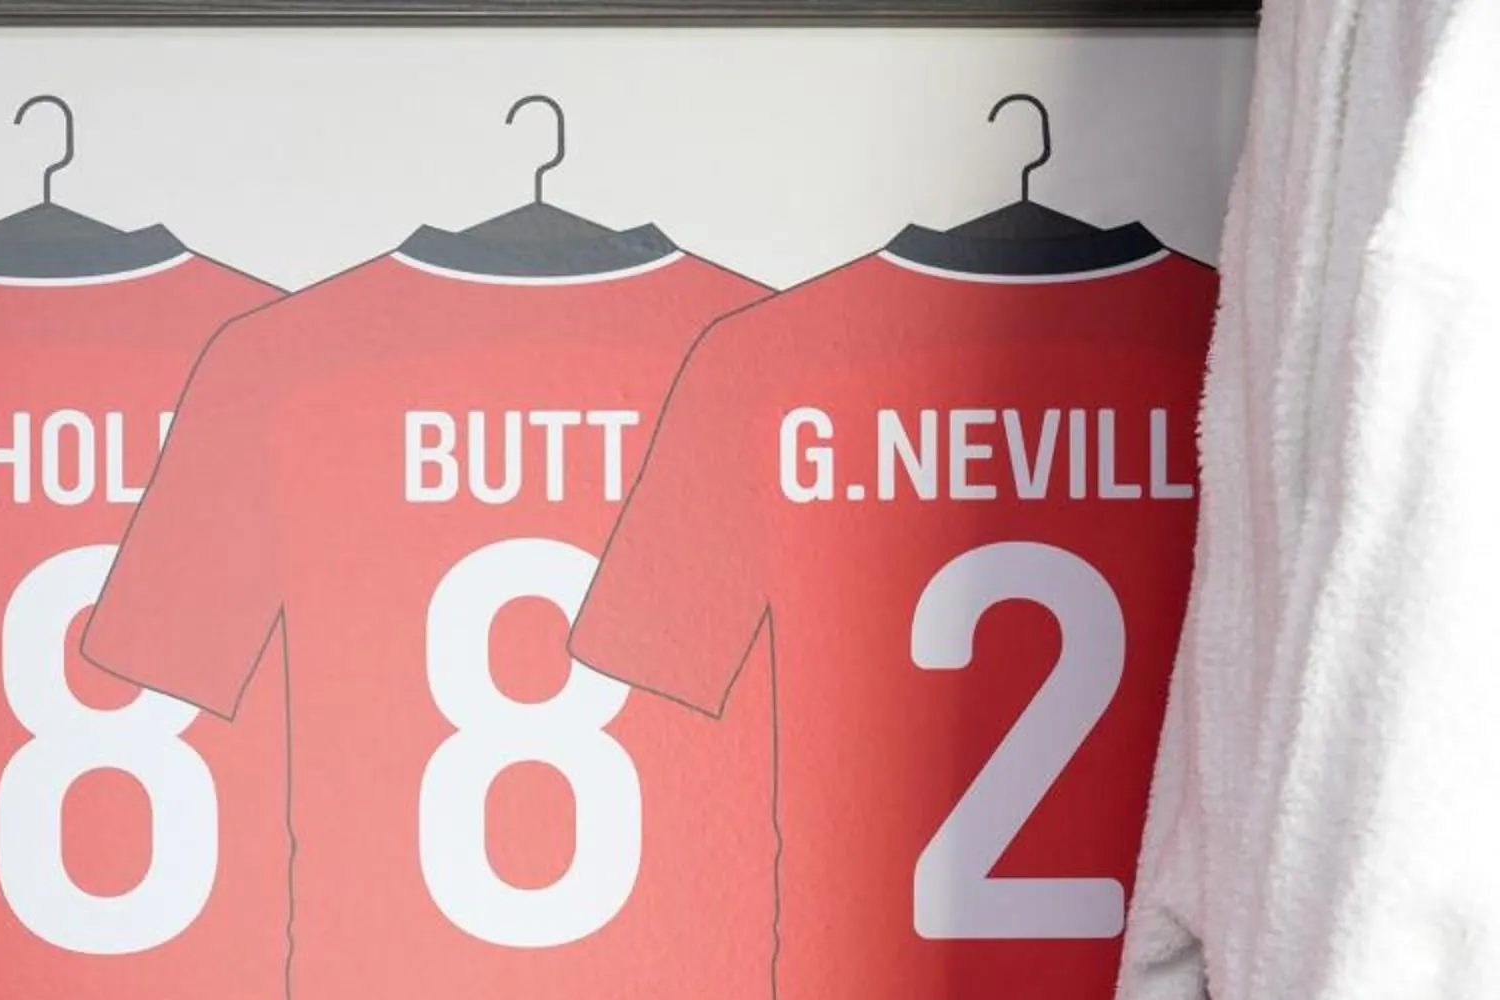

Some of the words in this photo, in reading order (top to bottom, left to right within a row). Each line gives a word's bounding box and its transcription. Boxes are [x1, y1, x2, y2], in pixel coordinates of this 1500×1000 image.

[405, 410, 640, 504] BUTT
[779, 406, 1195, 501] G.NEVILL
[418, 536, 643, 948] 8
[910, 541, 1126, 940] 2
